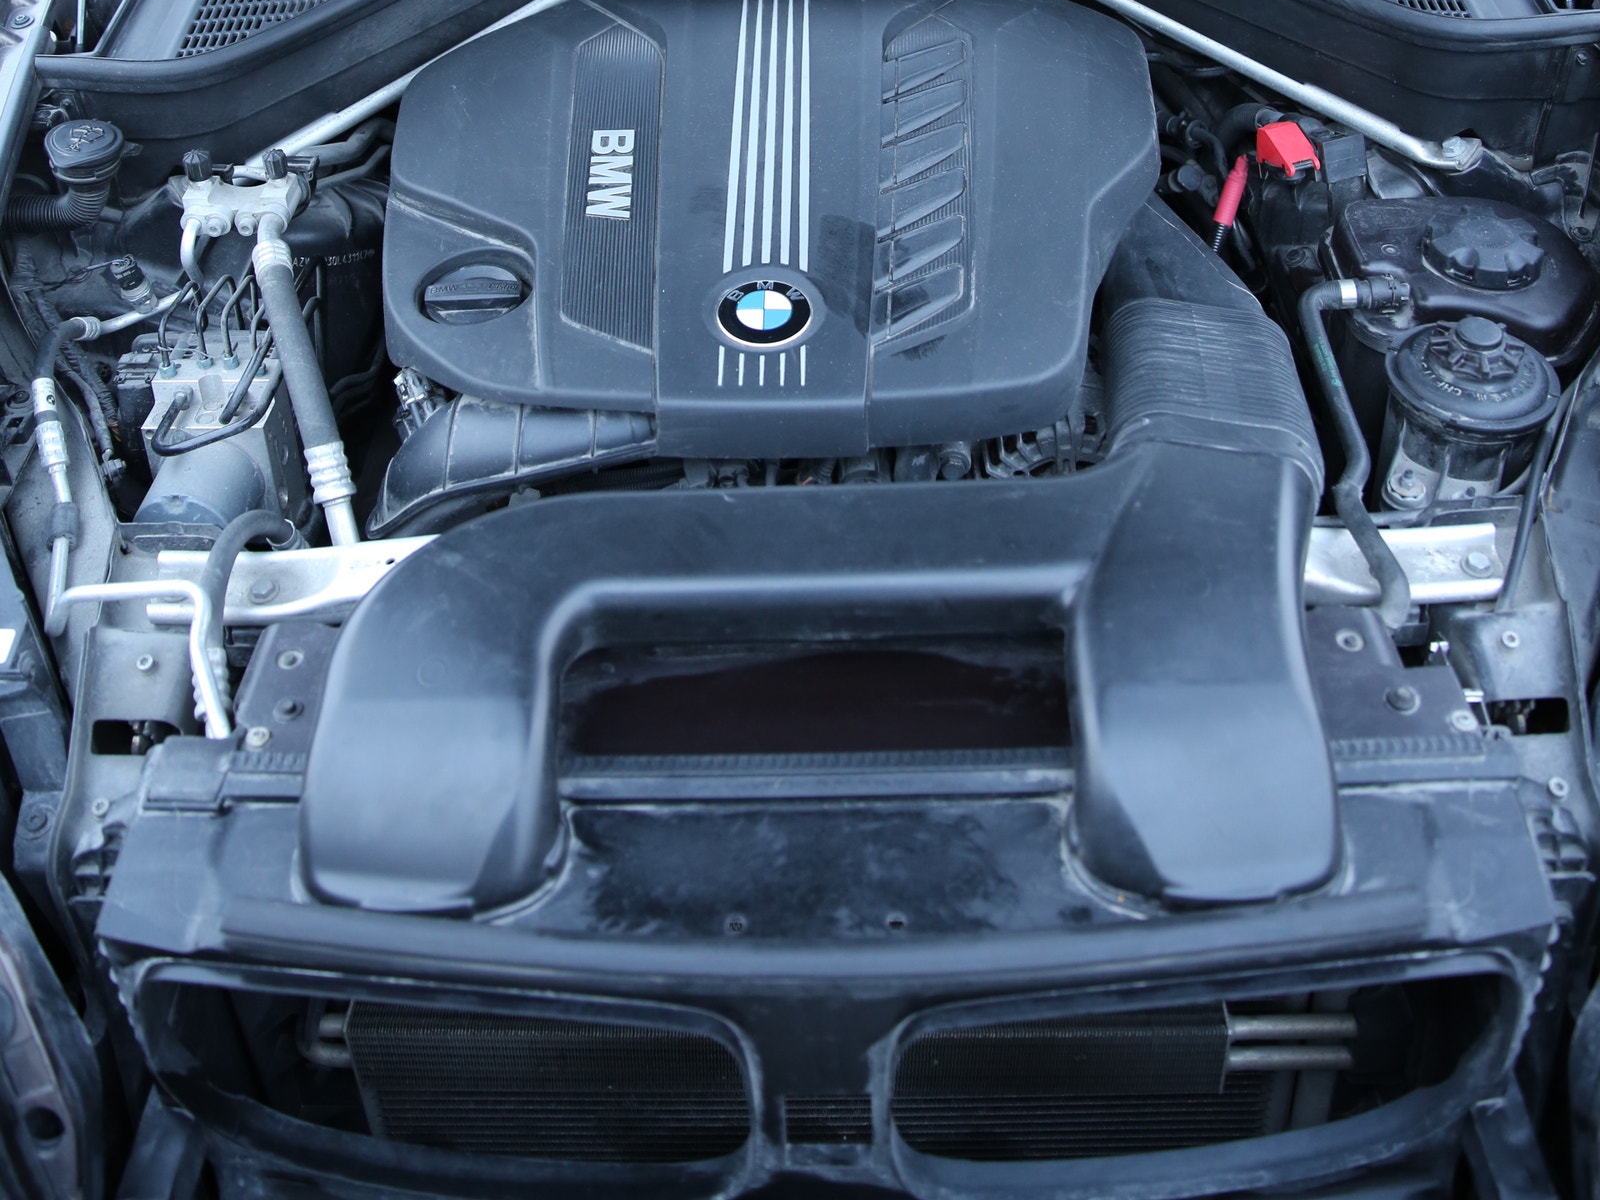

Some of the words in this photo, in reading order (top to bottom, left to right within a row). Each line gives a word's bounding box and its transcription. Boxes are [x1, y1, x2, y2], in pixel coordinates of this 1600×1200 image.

[586, 129, 635, 220] BMW
[430, 283, 459, 295] BMW
[726, 280, 805, 302] BMW
[1434, 380, 1463, 397] CHF
